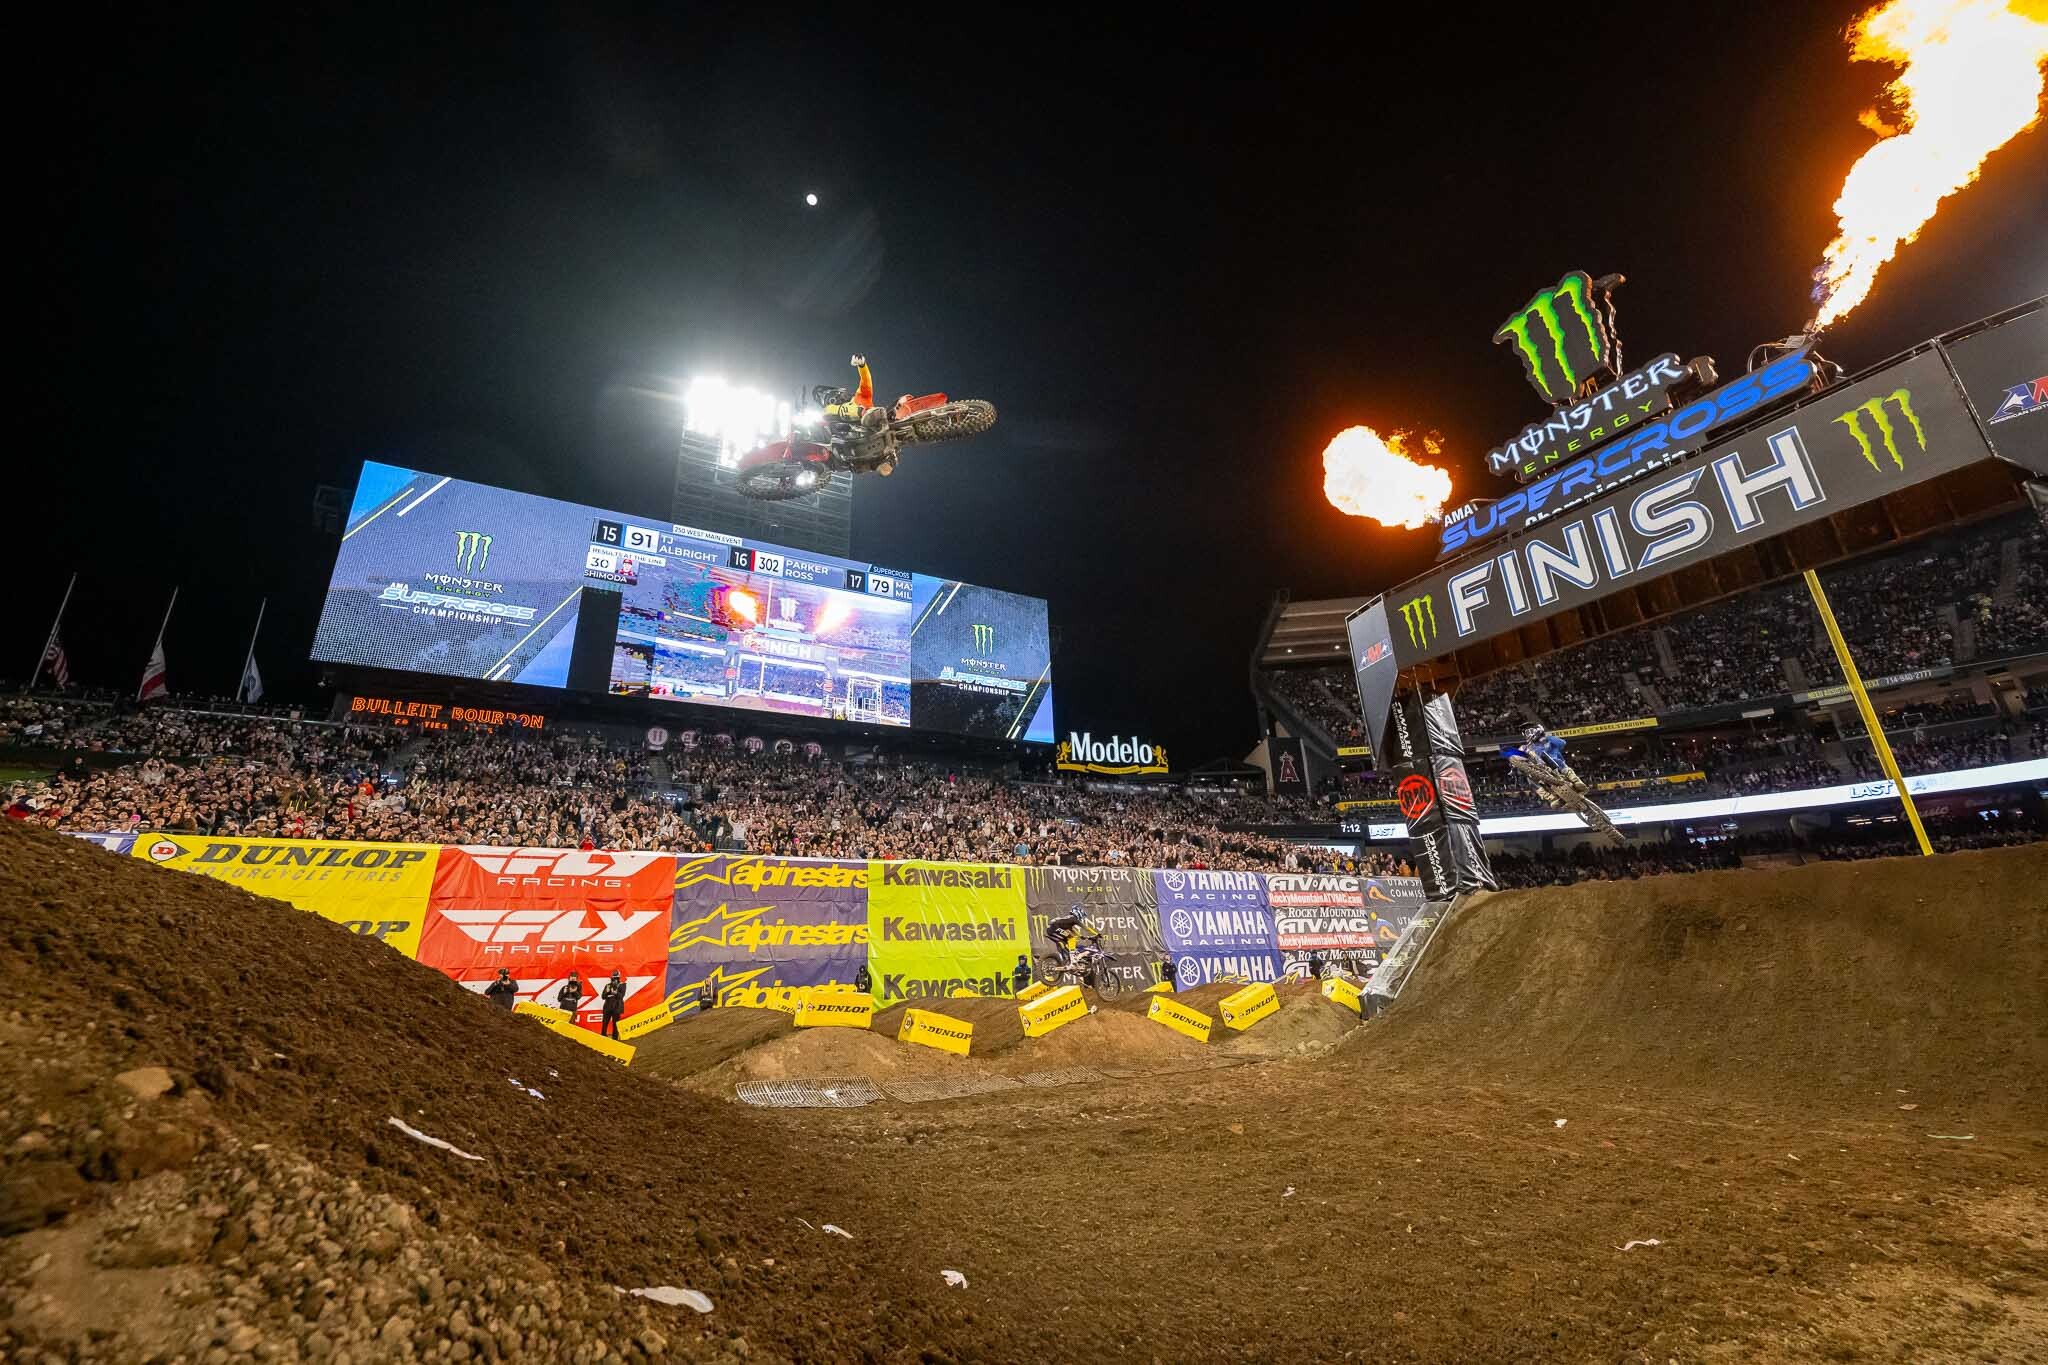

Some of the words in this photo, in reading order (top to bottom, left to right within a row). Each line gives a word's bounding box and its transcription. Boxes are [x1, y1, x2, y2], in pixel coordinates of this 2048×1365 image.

[1490, 356, 1684, 471] MONSTER
[1523, 400, 1652, 475] ENERGY
[1441, 351, 1811, 554] SUPERCROSS
[1444, 506, 1474, 528] AMA
[602, 526, 617, 542] 15
[687, 528, 704, 537] WEST
[705, 531, 721, 541] MAIN
[722, 535, 741, 545] EVENT
[1447, 424, 1827, 638] FINISH
[630, 532, 652, 549] 91
[661, 535, 674, 545] TJ
[659, 545, 719, 563] ALBRIGHT
[734, 551, 748, 567] 16
[590, 557, 609, 569] 30
[758, 556, 779, 573] 302
[785, 559, 829, 576] PARKER
[583, 569, 627, 583] SHIMODA
[785, 569, 814, 581] ROSS
[873, 566, 910, 579] SUPERCROSS
[390, 582, 409, 592] AMA
[424, 572, 504, 594] MONSTER
[850, 574, 862, 589] 17
[872, 579, 890, 593] 79
[378, 587, 538, 620] SUPERCROSS
[413, 605, 502, 625] CHAMPIONSHIP
[961, 657, 1007, 671] MONSTER
[958, 683, 1010, 696] CHAMPIONSHIP
[351, 696, 443, 719] BULLEIT
[1070, 731, 1154, 765] Modelo
[1850, 781, 1894, 799] LAST
[1340, 824, 1361, 833] 7:12
[192, 843, 427, 869] DUNLOP
[186, 865, 332, 881] MOTORCYCLE
[342, 869, 404, 883] TIRES
[496, 877, 622, 888] RACING
[732, 860, 868, 892] alpinestars
[883, 863, 1012, 889] Kawasaki
[1053, 868, 1132, 883] MONSTER
[1188, 870, 1260, 891] YAMAHA
[1066, 885, 1121, 893] ENERGY
[1269, 892, 1363, 907] RockyMountainATVMC.com
[1288, 907, 1318, 918] ROCKY
[1319, 907, 1365, 918] MOUNTAIN
[883, 917, 1016, 942] Kawasaki
[1192, 909, 1269, 935] YAMAHA
[729, 918, 868, 952] alpinestars
[1183, 937, 1266, 945] RACING
[1278, 933, 1375, 948] RockyMountainATVMC.com
[484, 944, 614, 955] RACING
[1200, 955, 1277, 983] YAMAHA
[883, 971, 1013, 1000] Kawasak
[816, 1004, 870, 1014] DUNLOP
[1044, 997, 1084, 1021] DUNLOP
[1245, 994, 1276, 1017] DUNLOP
[629, 1011, 668, 1031] DUNLOP
[1171, 1011, 1210, 1031] DUNLOP
[927, 1026, 972, 1041] DUNLOP
